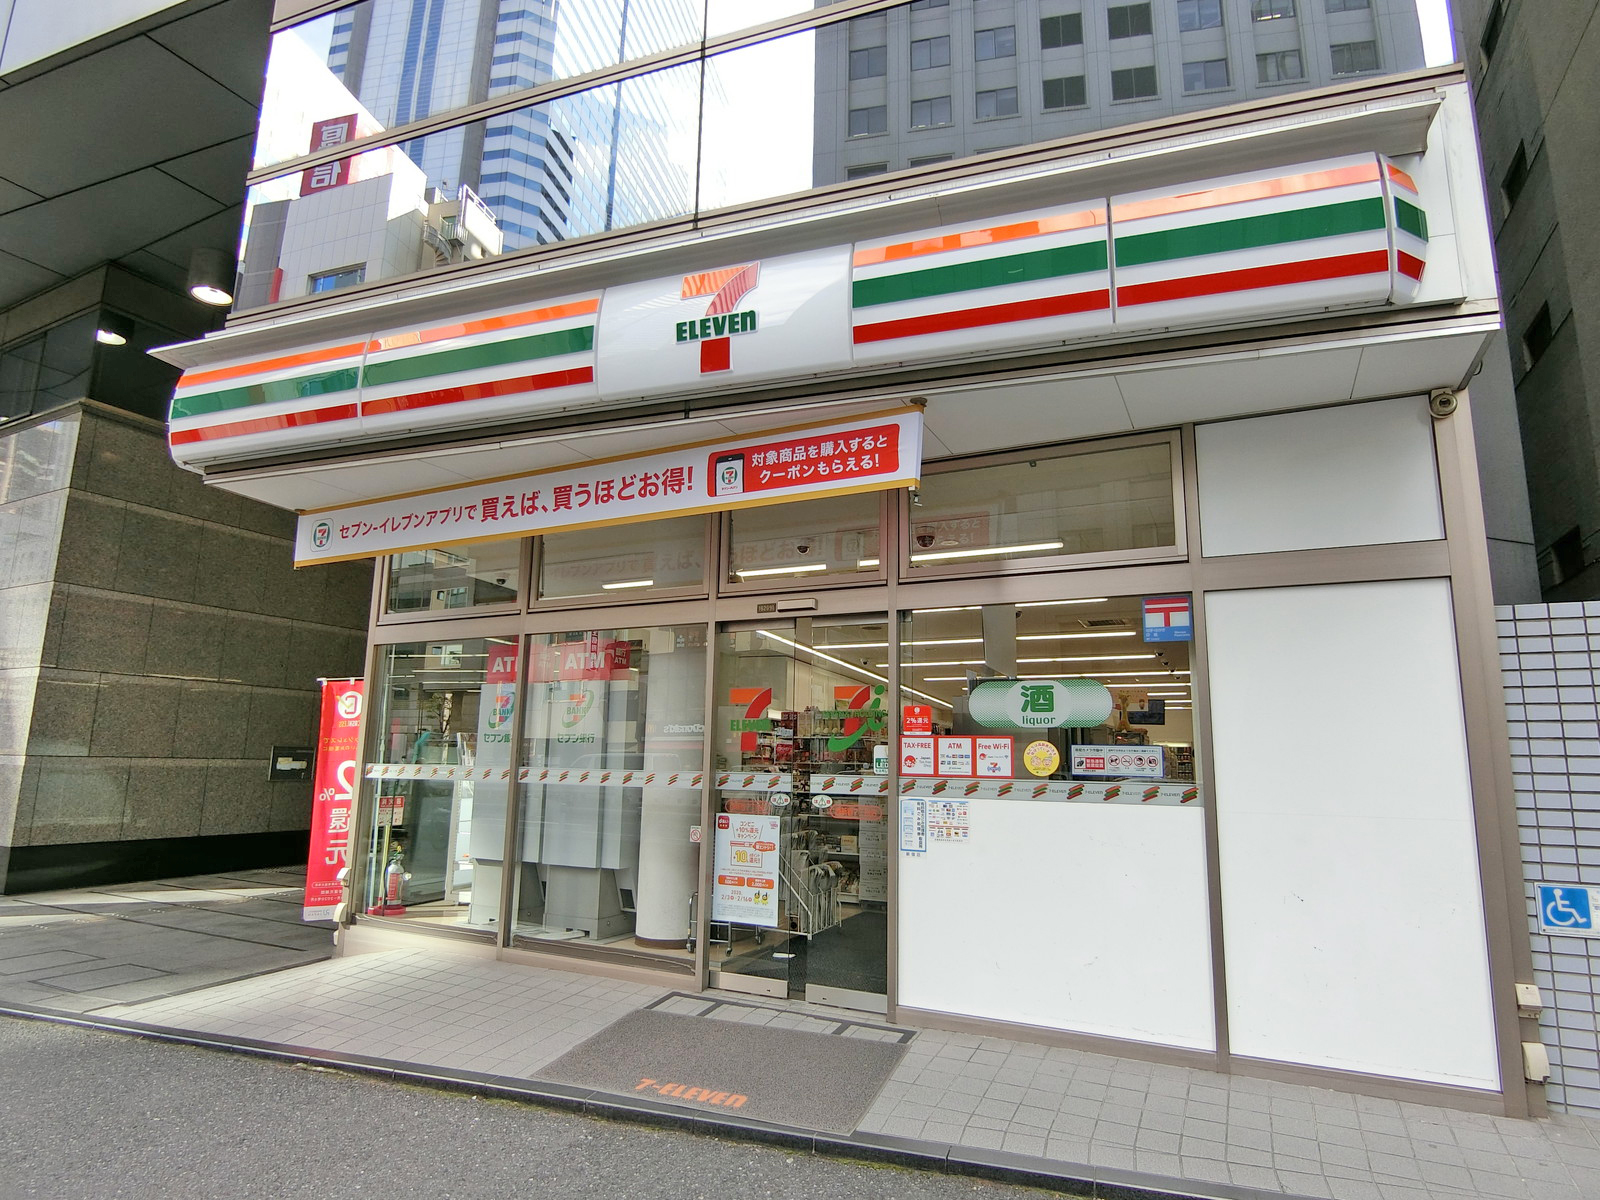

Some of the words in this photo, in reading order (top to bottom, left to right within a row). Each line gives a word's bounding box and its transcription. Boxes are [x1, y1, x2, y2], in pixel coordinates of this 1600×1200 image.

[751, 434, 888, 468] 対象商品を購入すると
[492, 656, 518, 673] AT
[1021, 685, 1055, 713] 酒
[1022, 715, 1056, 727] liquor
[483, 733, 512, 743] セブン銀
